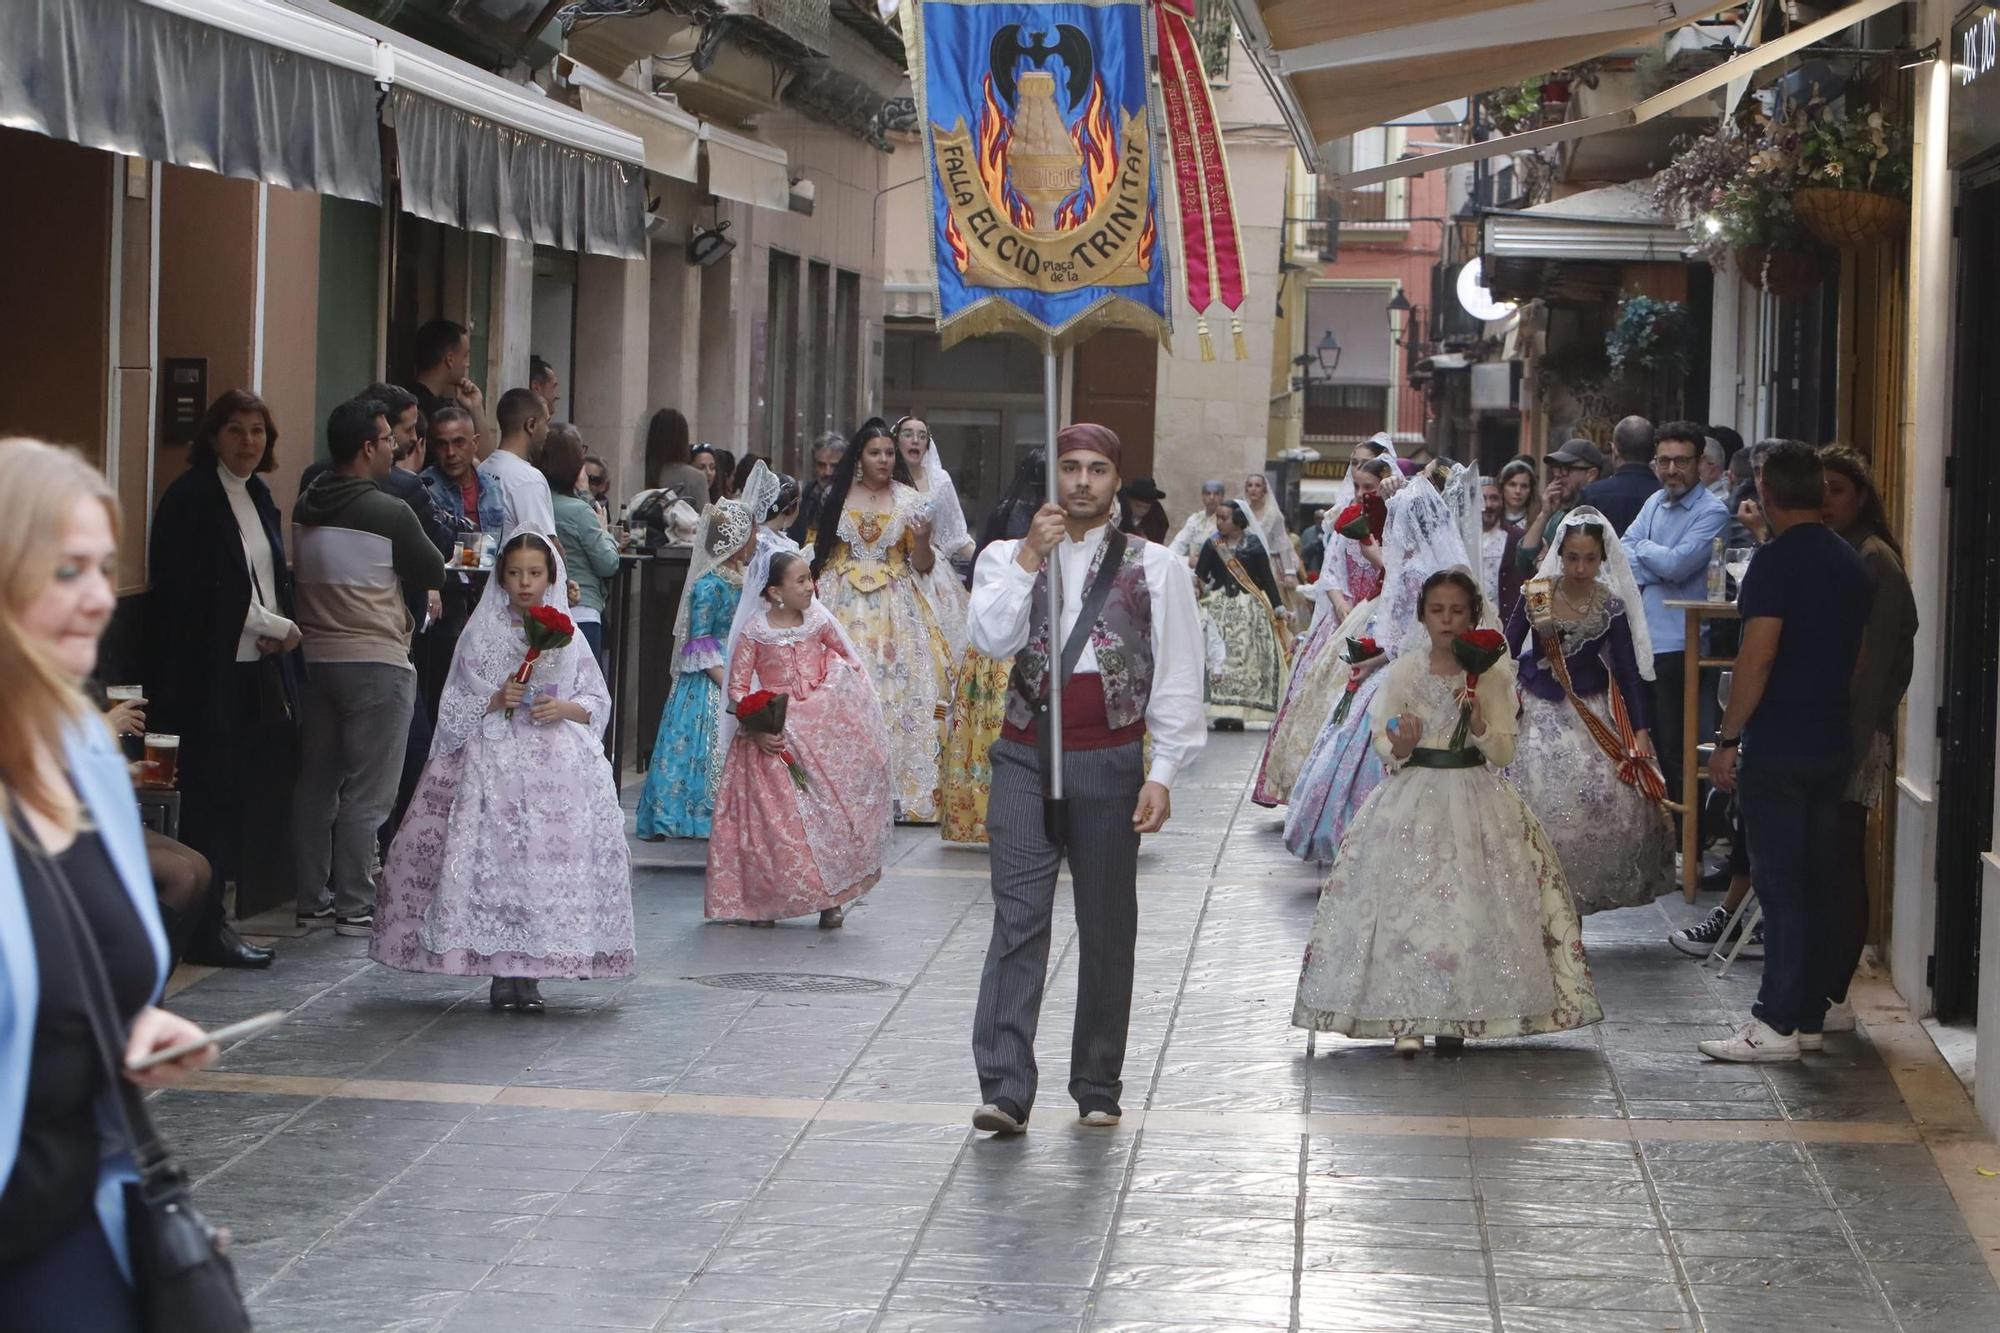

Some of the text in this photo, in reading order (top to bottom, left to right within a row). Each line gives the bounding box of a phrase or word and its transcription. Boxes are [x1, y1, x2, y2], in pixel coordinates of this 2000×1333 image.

[944, 146, 1040, 276] FALLA EL CID
[1070, 139, 1143, 269] TRINITAT
[1183, 180, 1199, 213] 2024
[1207, 182, 1228, 216] Real
[1043, 260, 1075, 272] Plaça
[1050, 269, 1079, 282] de la
